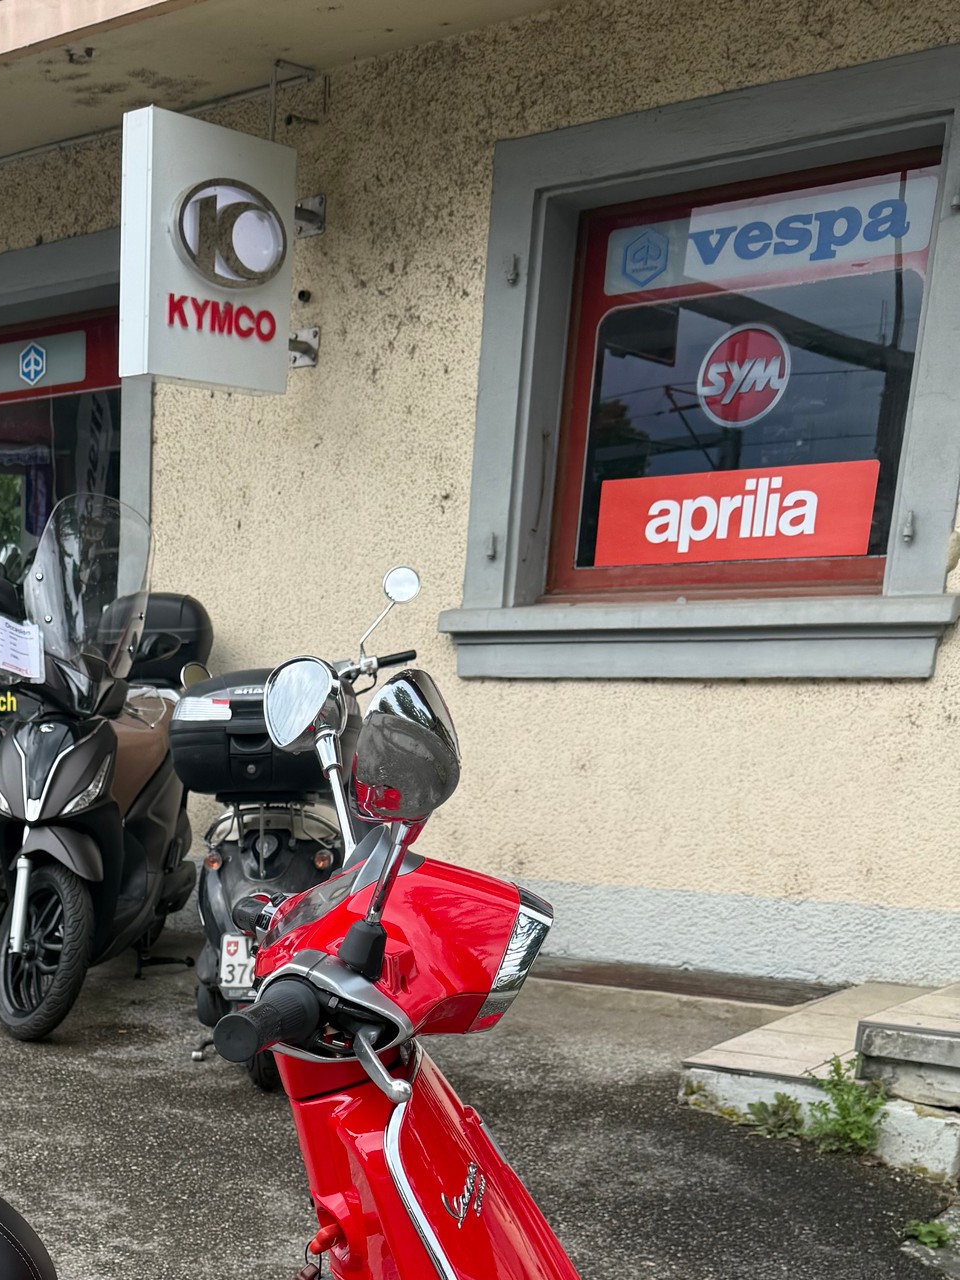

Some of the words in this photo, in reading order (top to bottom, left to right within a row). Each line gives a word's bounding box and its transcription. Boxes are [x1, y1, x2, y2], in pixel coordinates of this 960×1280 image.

[690, 198, 911, 262] vespa
[168, 293, 276, 342] KYMCO
[698, 356, 786, 405] SYM
[645, 476, 819, 553] aprilia
